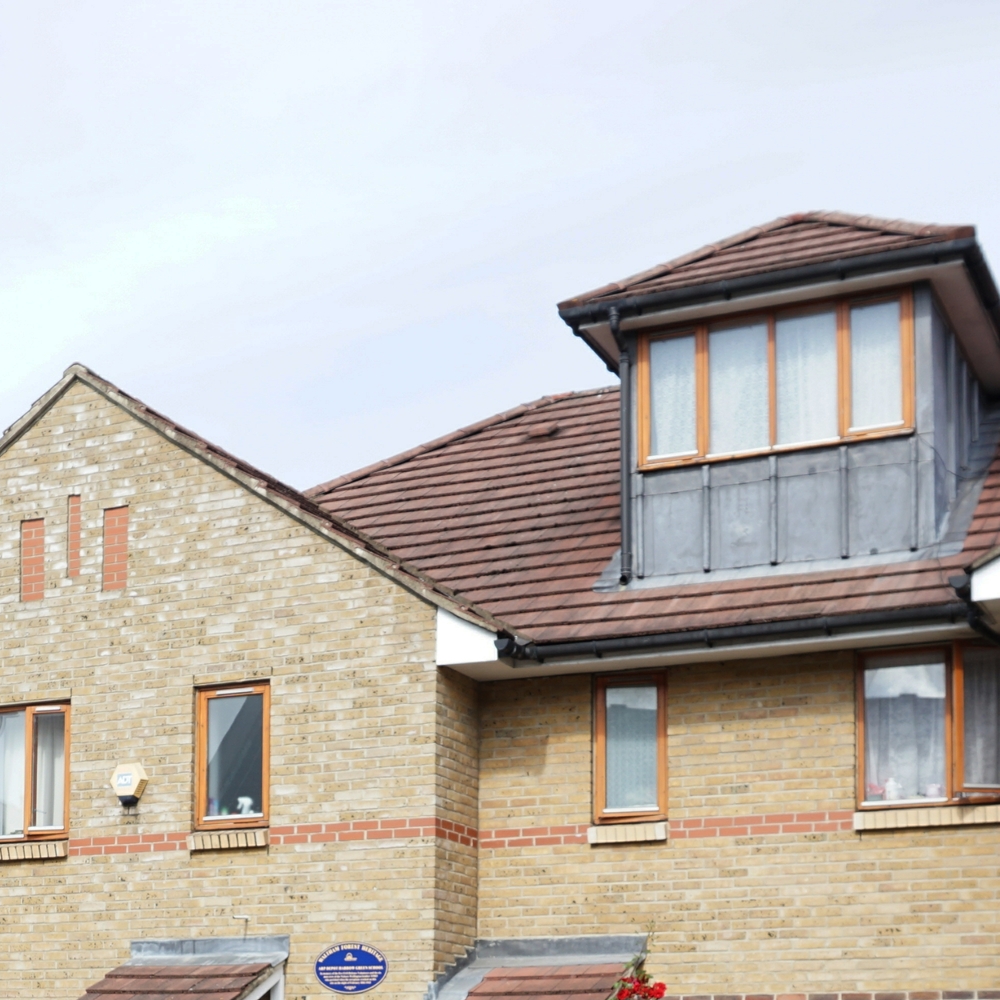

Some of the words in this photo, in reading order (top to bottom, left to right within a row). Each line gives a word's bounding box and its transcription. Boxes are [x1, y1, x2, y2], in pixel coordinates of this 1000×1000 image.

[117, 775, 132, 784] ADT
[318, 946, 340, 963] WALTHAM
[361, 945, 383, 963] HERITAGE
